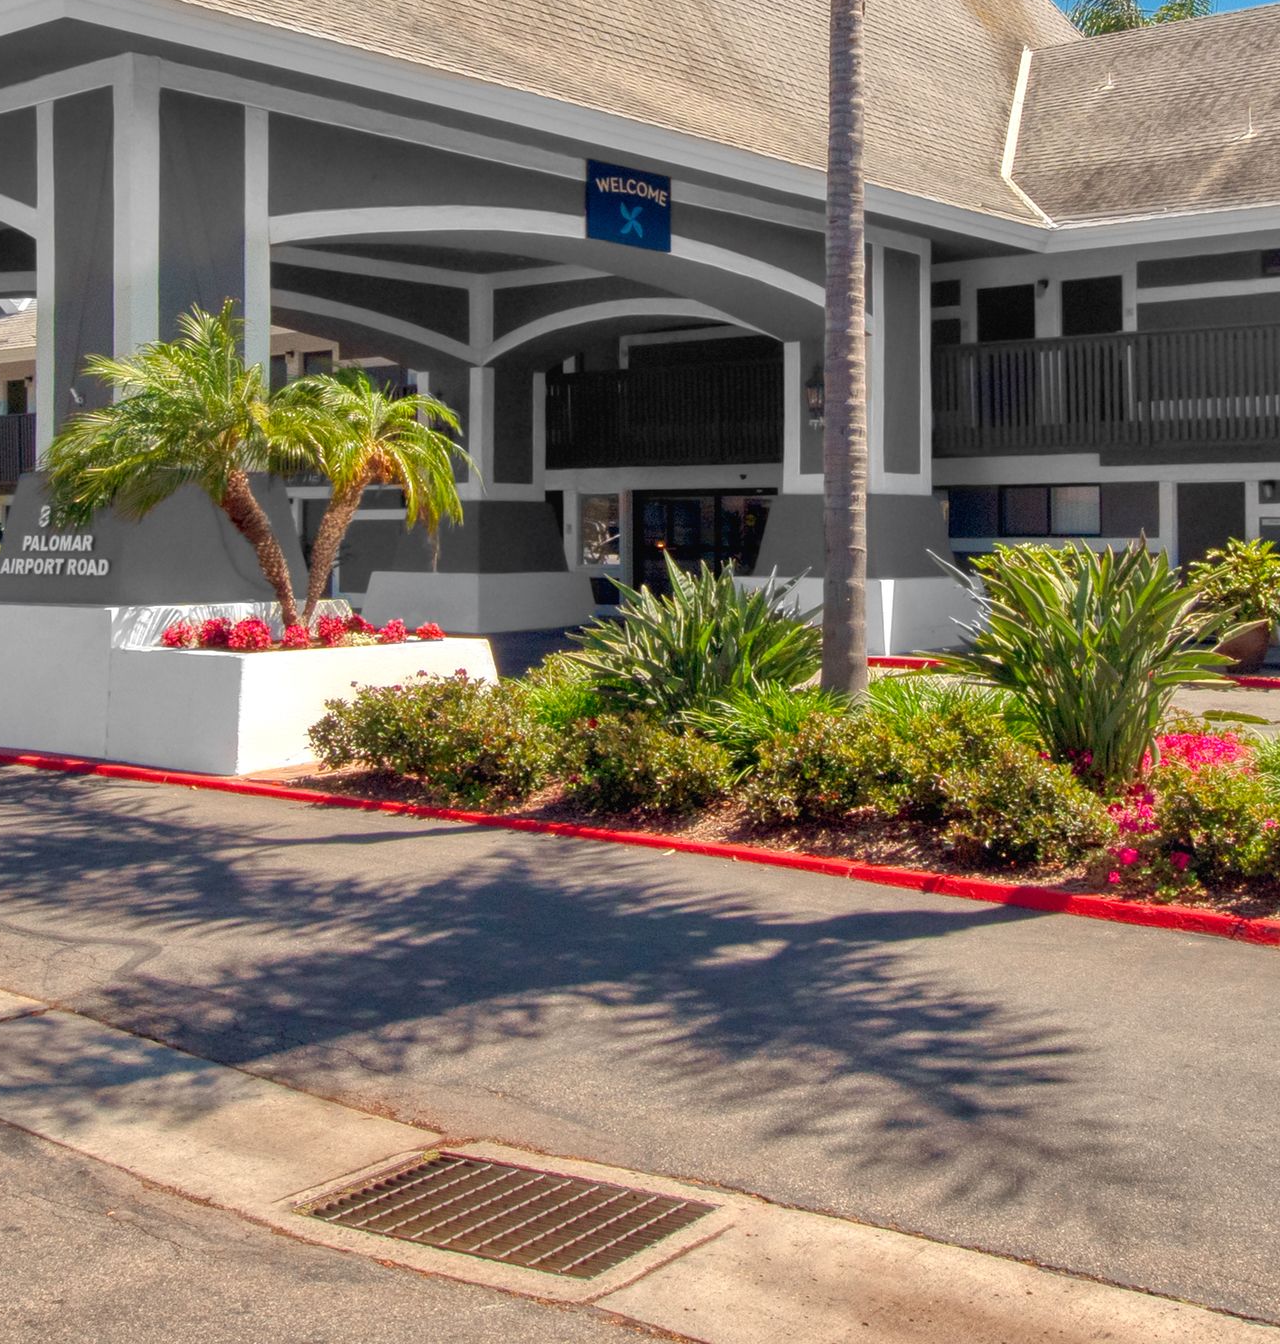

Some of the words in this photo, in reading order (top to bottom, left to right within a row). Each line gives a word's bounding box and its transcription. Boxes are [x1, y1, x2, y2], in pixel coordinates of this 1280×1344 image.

[596, 177, 669, 207] WELCOME
[22, 535, 93, 552] PALOMAR
[0, 558, 64, 574] AIRPORT
[66, 559, 109, 576] ROAD
